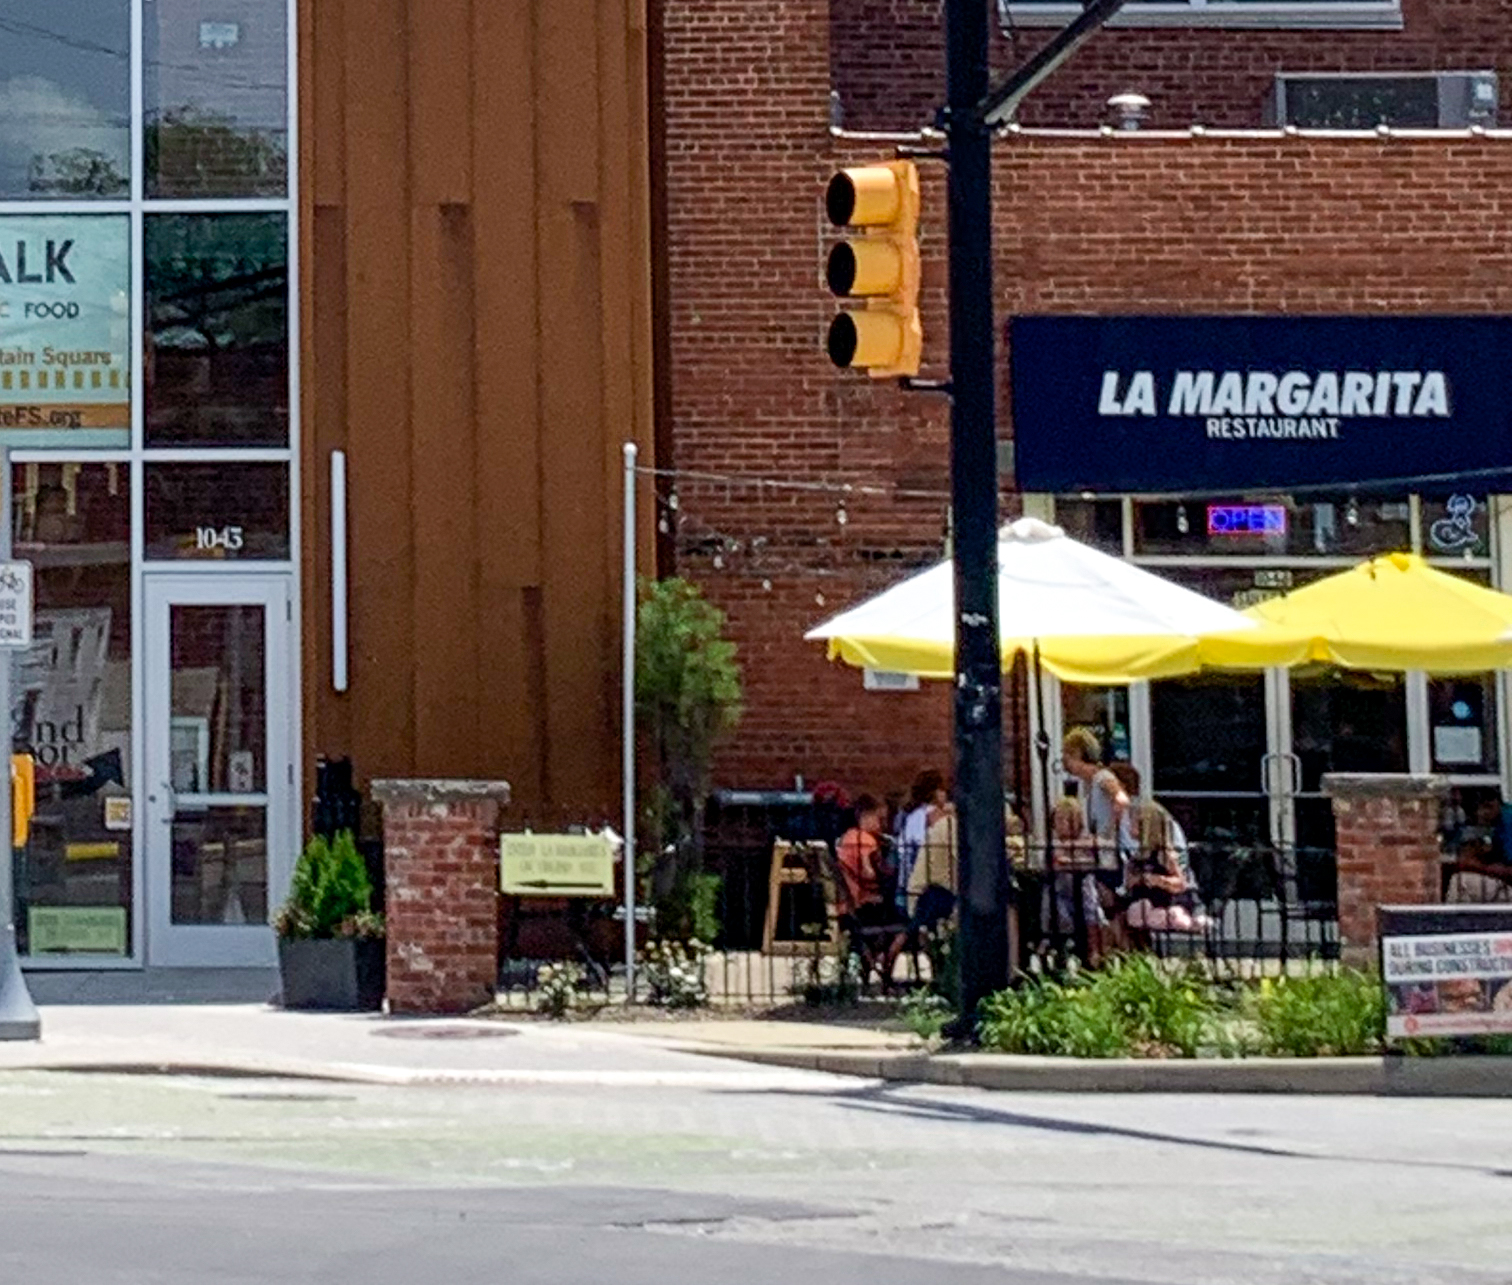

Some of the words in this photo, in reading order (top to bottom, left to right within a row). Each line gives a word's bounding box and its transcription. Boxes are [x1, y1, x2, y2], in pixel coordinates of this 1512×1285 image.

[24, 301, 81, 319] FOOD
[1098, 370, 1157, 416] LA
[1168, 370, 1452, 416] MARGARITA
[1206, 417, 1341, 440] RESTAURANT
[1212, 507, 1284, 532] OPEN
